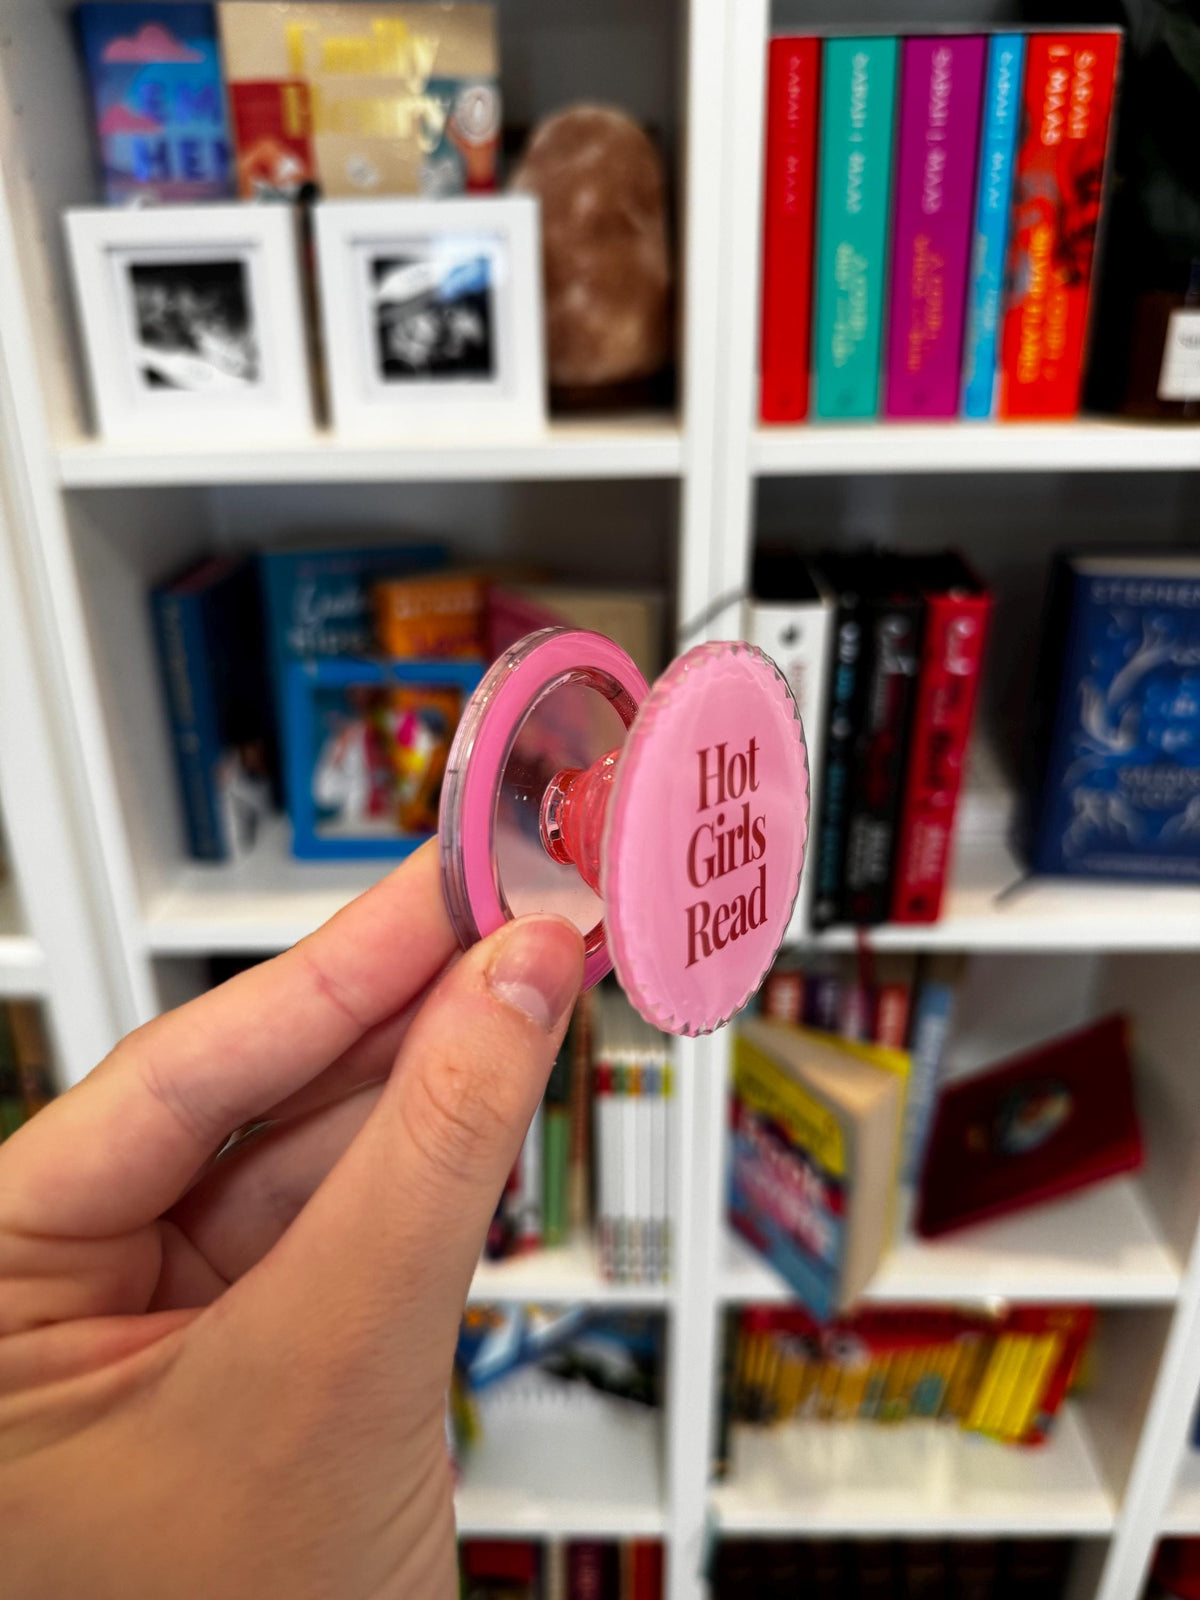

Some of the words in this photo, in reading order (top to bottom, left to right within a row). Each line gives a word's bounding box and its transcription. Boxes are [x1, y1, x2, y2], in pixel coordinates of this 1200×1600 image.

[696, 736, 760, 813] Hot
[686, 801, 766, 889] Girls
[685, 863, 768, 969] Read
